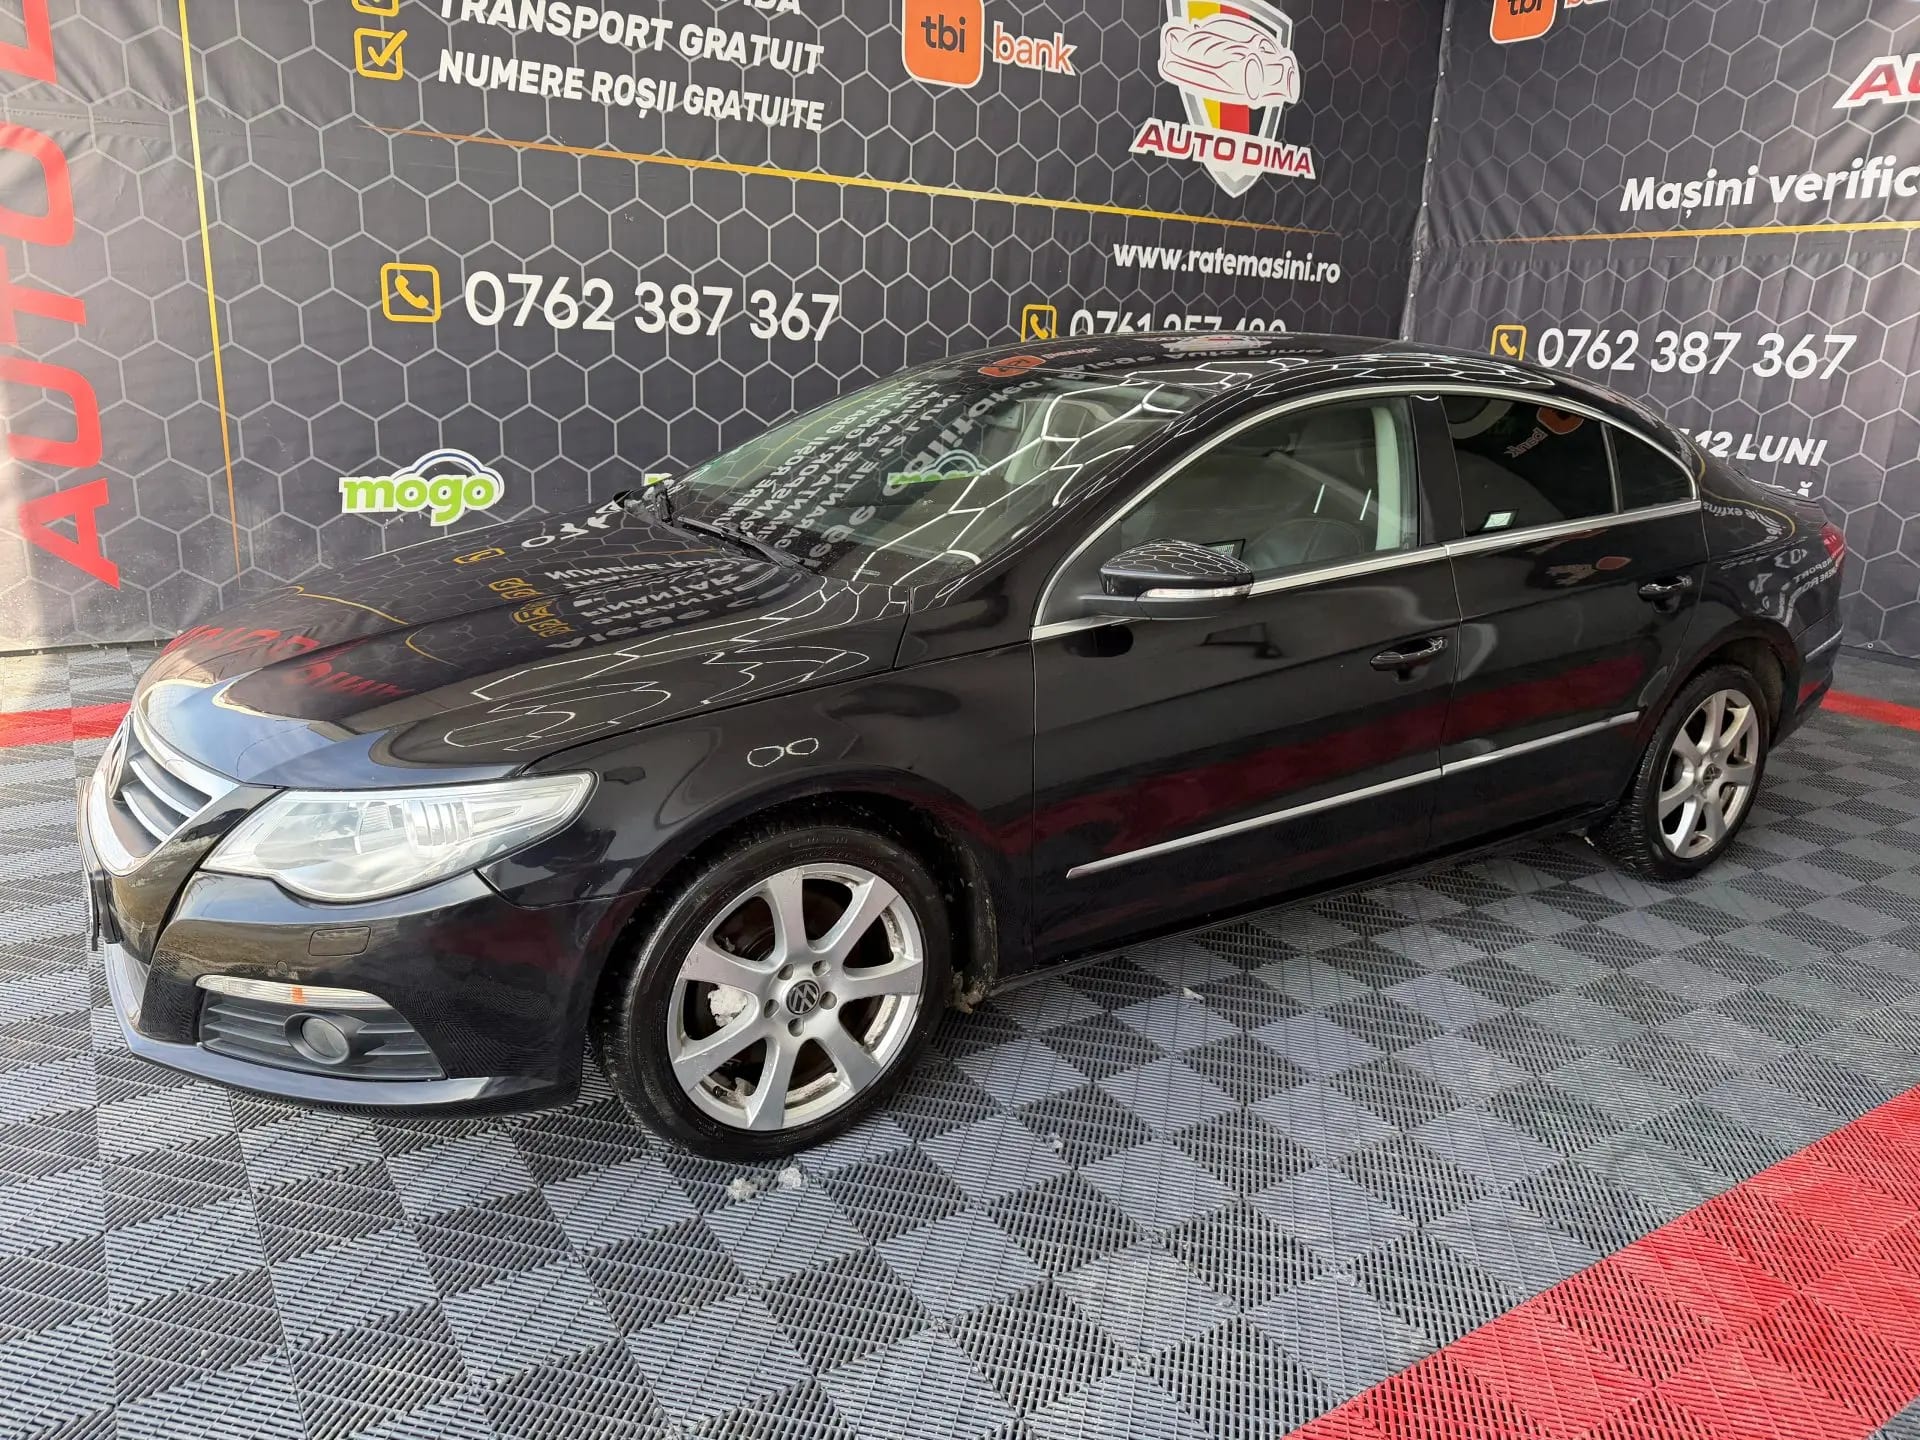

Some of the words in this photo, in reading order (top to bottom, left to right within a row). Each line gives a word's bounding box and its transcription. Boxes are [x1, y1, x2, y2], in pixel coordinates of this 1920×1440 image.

[441, 0, 673, 51] TRANSPORT
[679, 23, 825, 75] GRATUIT
[920, 14, 967, 53] tbi
[995, 26, 1075, 75] bank
[438, 49, 585, 100] NUMERE
[591, 71, 677, 118] ROȘII
[682, 83, 825, 131] GRATUITE
[1137, 123, 1234, 162] AUTO
[1242, 144, 1312, 175] DIMA
[1620, 165, 1758, 218] Mașini
[1113, 242, 1341, 284] www.ratemasini.ro
[464, 271, 615, 331] 0762
[634, 281, 733, 336] 387
[749, 289, 840, 342] 367
[1538, 327, 1638, 371] 0762
[1650, 331, 1741, 374] 387
[1753, 334, 1857, 380] 367
[1736, 433, 1828, 467] LUNI
[343, 473, 497, 523] mogo
